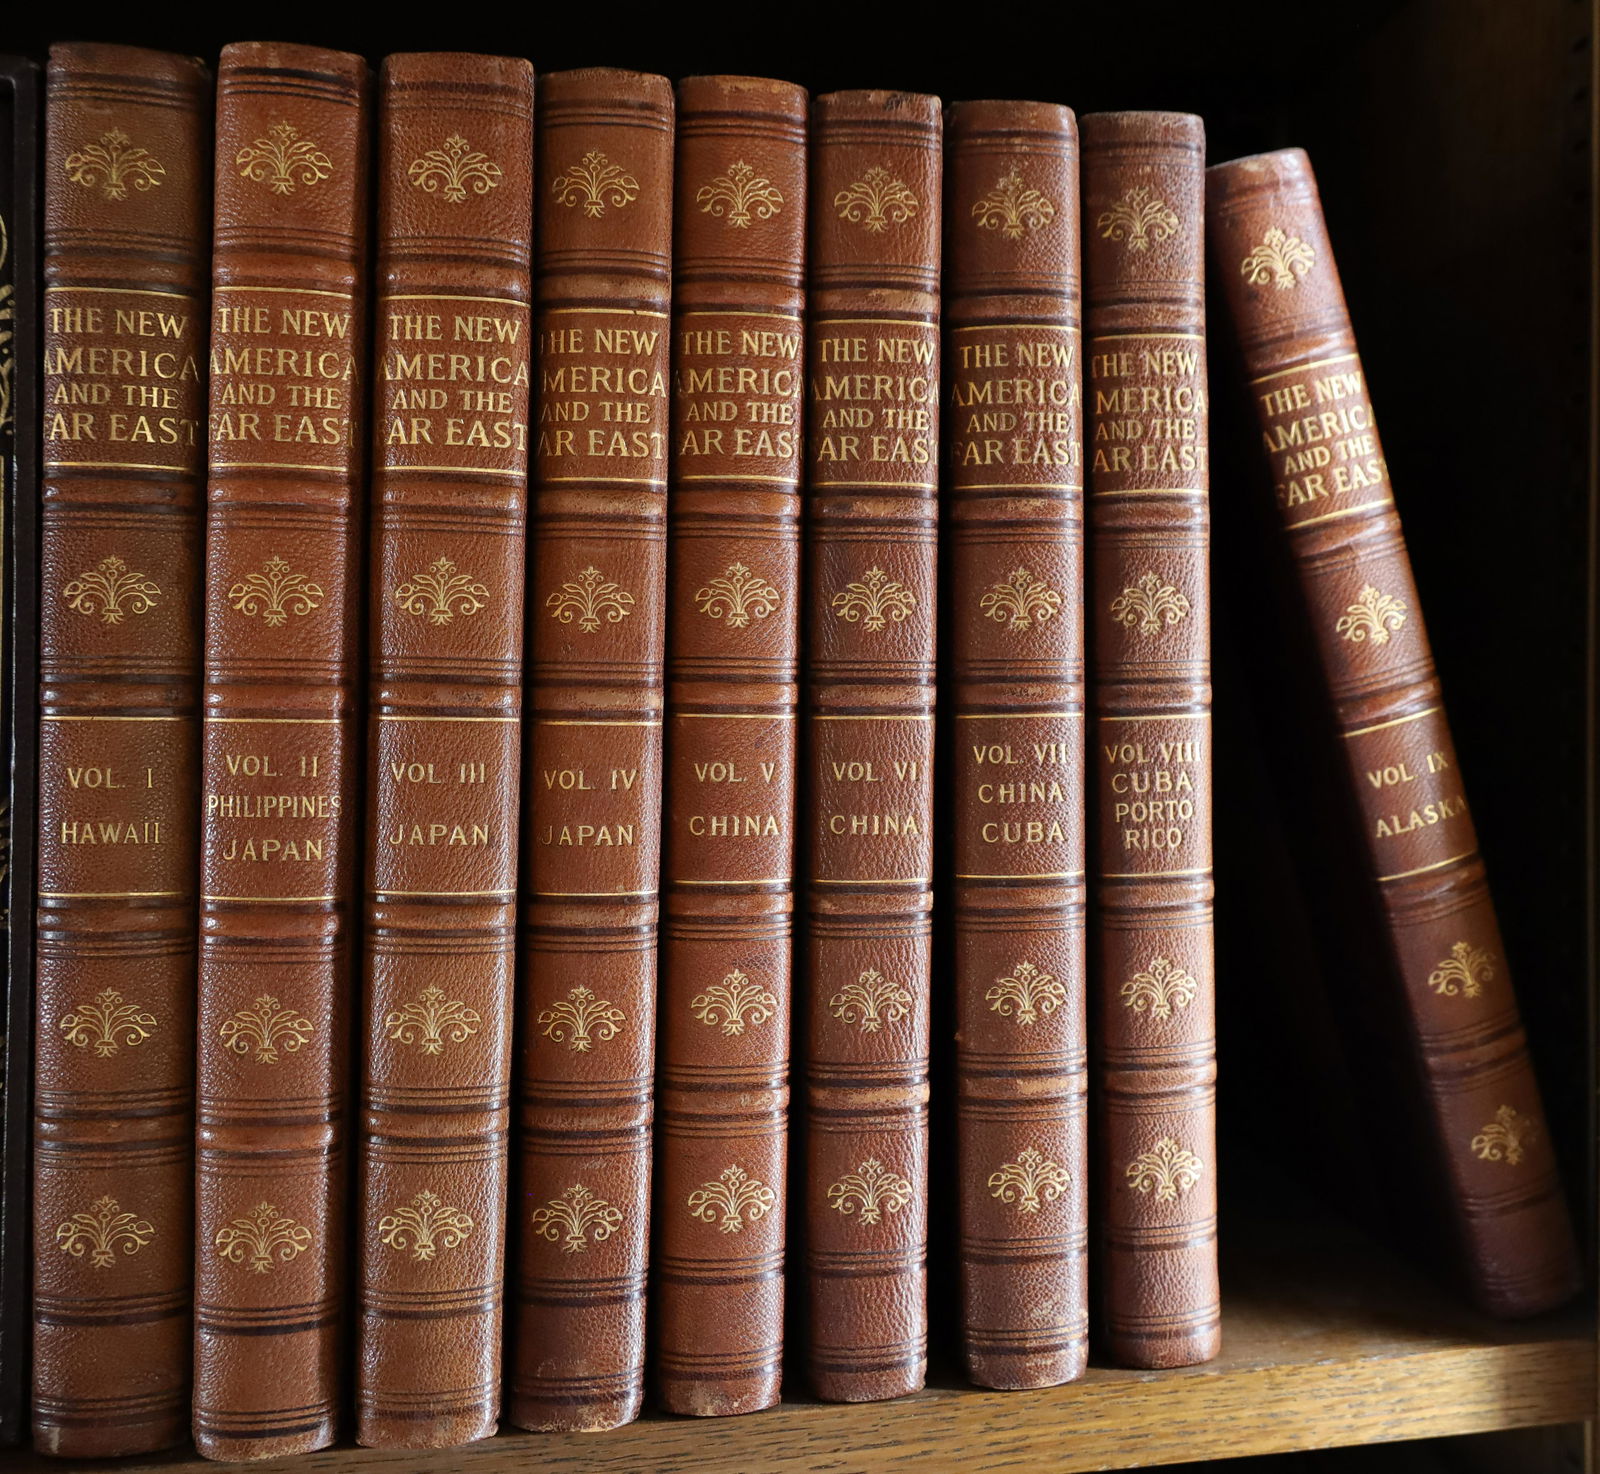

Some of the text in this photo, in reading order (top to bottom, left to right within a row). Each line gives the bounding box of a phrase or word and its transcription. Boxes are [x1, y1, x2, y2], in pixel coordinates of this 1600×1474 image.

[51, 307, 188, 339] THE NEW
[218, 307, 352, 339] THE NEW
[389, 315, 522, 345] THE NEW
[541, 328, 660, 356] HE NEW
[682, 329, 800, 360] THE NEW
[819, 338, 936, 366] THE NEW
[209, 348, 360, 385] AMERICA
[960, 342, 1074, 369] THE NEW
[1142, 350, 1199, 377] NEW
[376, 354, 530, 388] AMERICA
[543, 366, 667, 399] MERICA
[53, 383, 181, 410] AND THE
[221, 383, 343, 410] AND THE
[392, 388, 515, 414] AND THE
[951, 378, 1081, 408] AMERICA
[1095, 386, 1208, 415] MERICA
[1260, 371, 1363, 417] THE NEW
[541, 401, 652, 424] AND THE
[686, 400, 795, 425] AND THE
[822, 407, 930, 431] AND THE
[966, 411, 1071, 434] AND THE
[108, 414, 199, 447] EAST
[445, 418, 529, 451] EAST
[1096, 417, 1197, 441] AND THE
[538, 429, 665, 460] AR EAST
[680, 430, 725, 456] AR
[817, 435, 861, 462] AR
[1012, 437, 1081, 467] EAST
[1283, 434, 1376, 476] AND THE
[1092, 443, 1208, 473] AR EAST
[1033, 743, 1068, 766] VII
[1160, 741, 1201, 763] VIII
[1426, 752, 1448, 774] IX
[66, 767, 153, 789] VOL. I
[226, 754, 319, 777] VOL. II
[460, 763, 485, 784] III
[694, 762, 776, 784] VOL. V
[894, 760, 919, 783] VI
[610, 768, 638, 790] IV
[1112, 770, 1194, 794] CUBA
[978, 781, 1065, 804] CHINA
[208, 794, 342, 818] PHILIPPINES
[1115, 799, 1194, 823] PORTO
[1375, 795, 1467, 838] ALASKA
[390, 823, 489, 846] JAPAN
[541, 825, 635, 847] JAPAN
[689, 815, 781, 836] CHINA
[829, 814, 922, 836] CHINA
[982, 820, 1068, 843] CUBA
[223, 839, 322, 861] JAPAN
[1124, 826, 1183, 851] RICO
